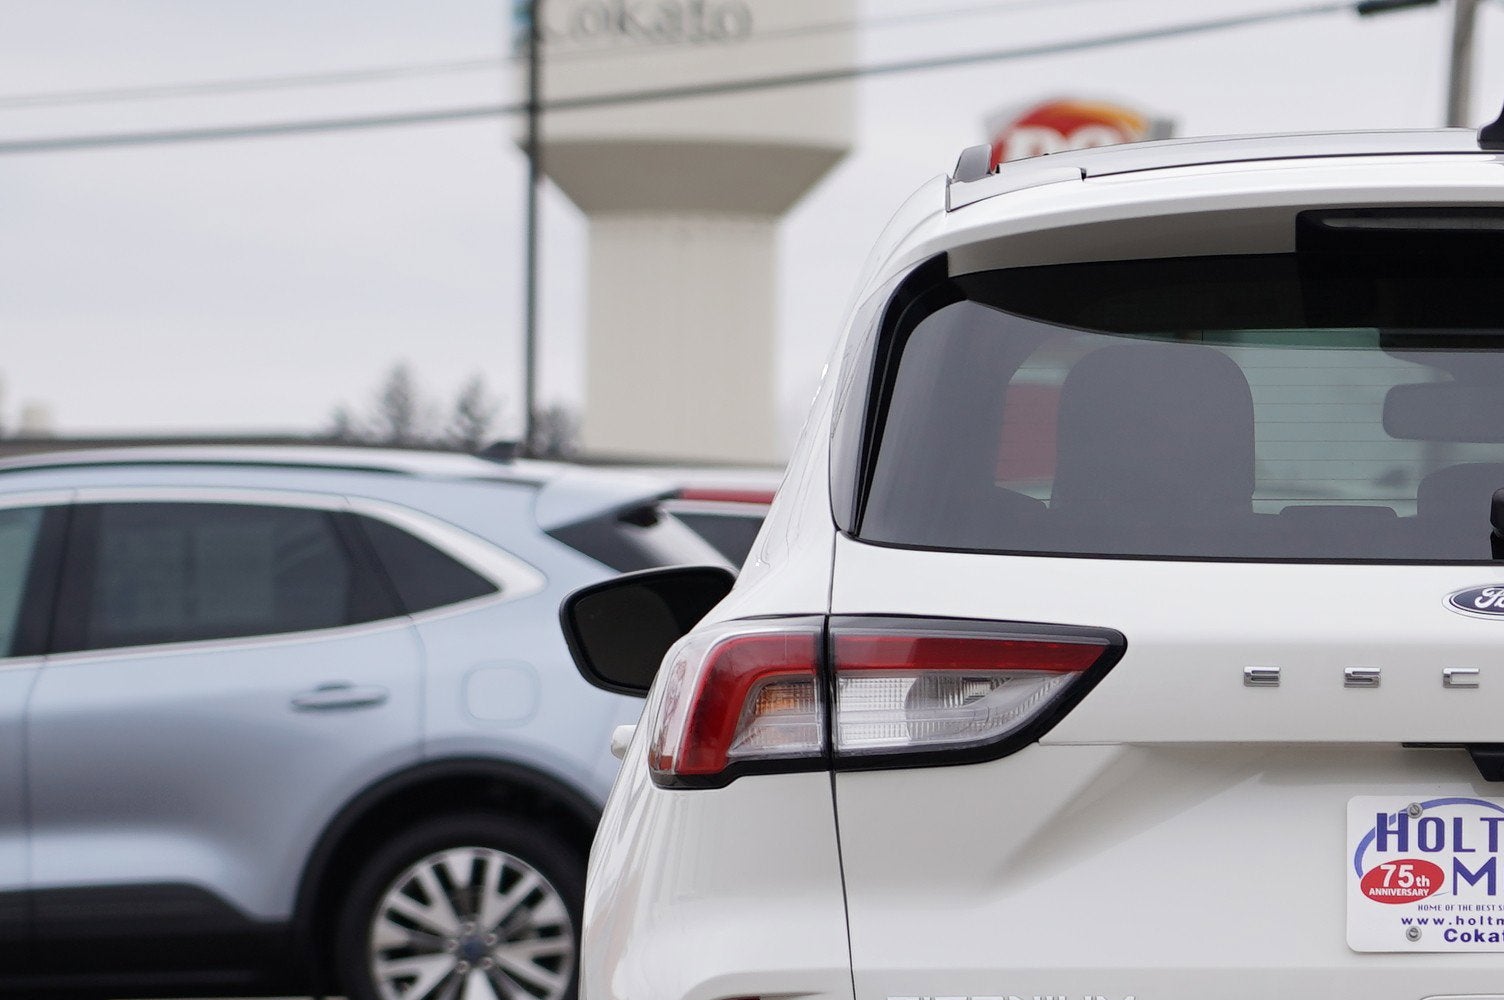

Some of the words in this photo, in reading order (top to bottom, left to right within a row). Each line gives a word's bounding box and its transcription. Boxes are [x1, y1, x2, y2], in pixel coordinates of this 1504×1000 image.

[1380, 863, 1431, 888] 75th
[1368, 887, 1430, 897] ANNIVERSARY
[1417, 904, 1442, 912] HOME
[1444, 904, 1454, 912] OF
[1458, 904, 1473, 912] THE
[1475, 904, 1495, 912] BEST
